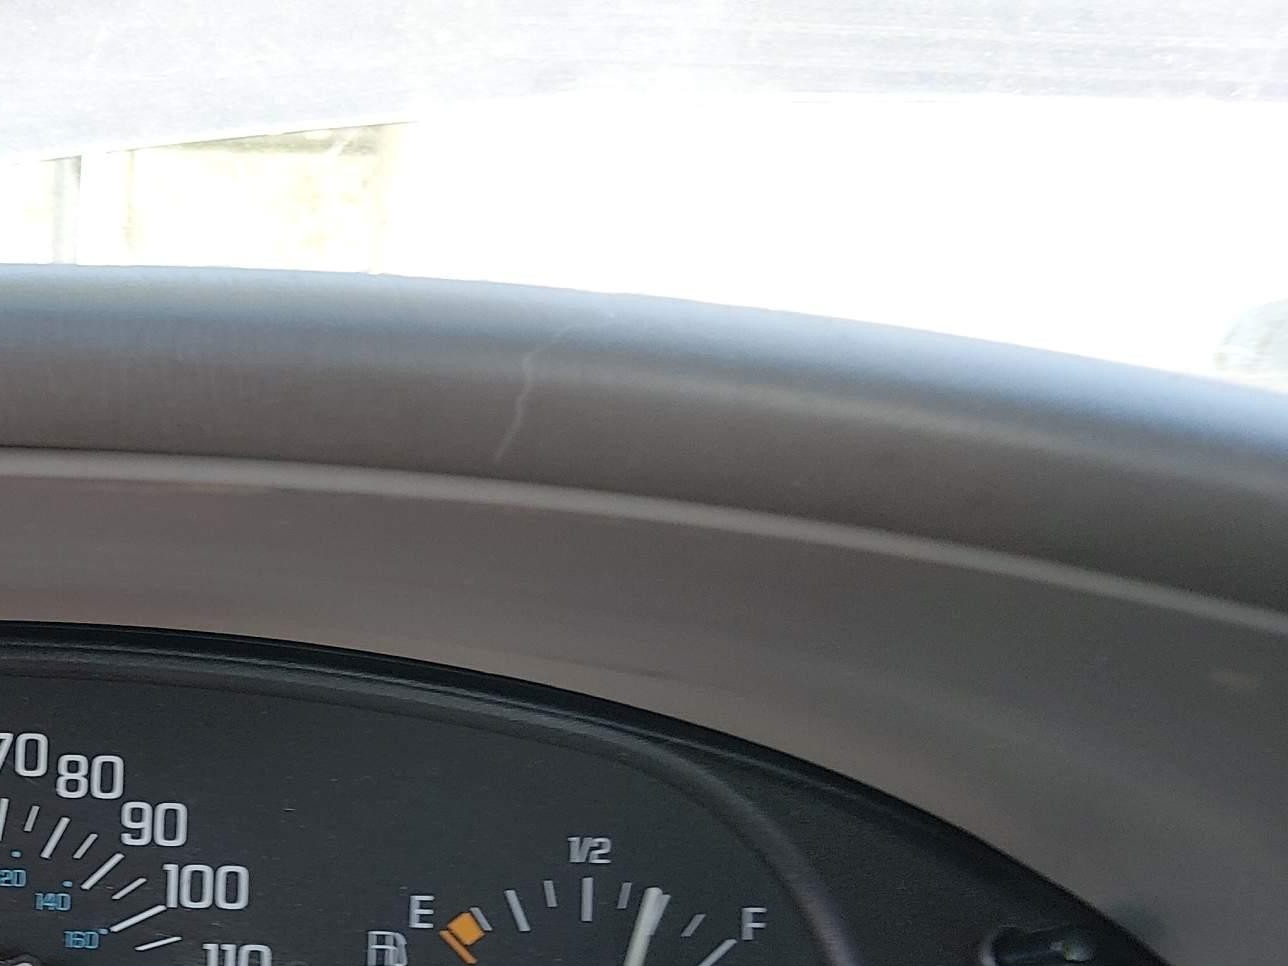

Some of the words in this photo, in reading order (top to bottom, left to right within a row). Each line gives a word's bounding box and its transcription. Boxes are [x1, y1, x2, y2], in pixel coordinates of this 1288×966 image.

[56, 754, 124, 799] 80
[121, 801, 188, 847] 90
[34, 893, 71, 911] 140
[163, 863, 249, 910] 100
[410, 895, 434, 928] E
[742, 907, 767, 940] F
[64, 931, 99, 949] 160
